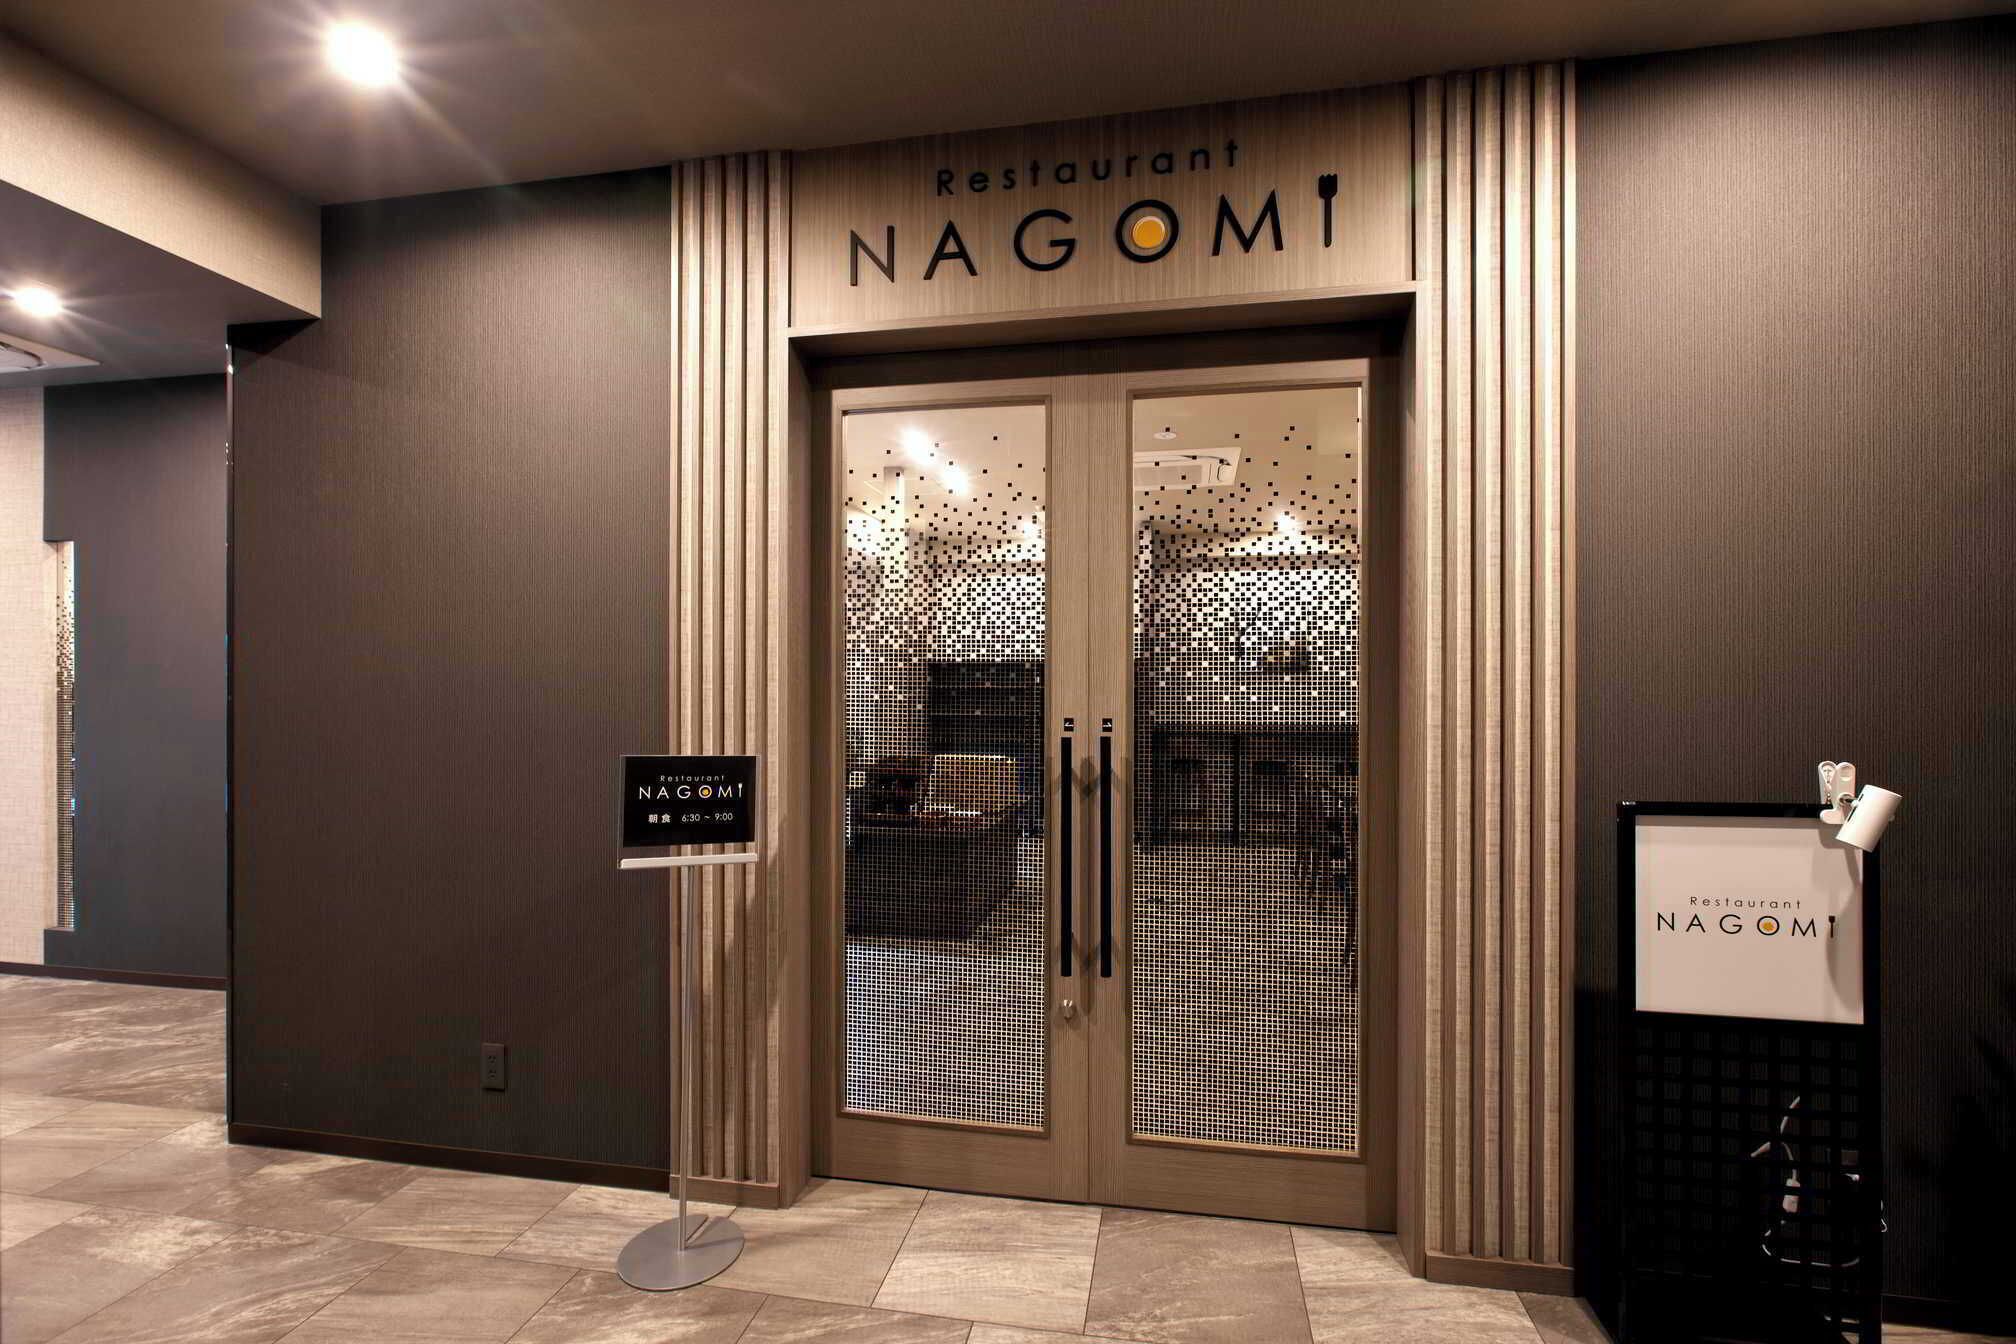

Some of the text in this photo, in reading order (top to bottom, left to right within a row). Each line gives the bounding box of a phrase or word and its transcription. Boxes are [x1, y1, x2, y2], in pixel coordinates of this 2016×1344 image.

[936, 138, 1239, 197] Restaurant
[849, 172, 1339, 288] NAGOMI
[659, 774, 725, 783] Restaurant
[638, 783, 743, 800] NAGOMI
[681, 813, 701, 823] 6:30
[714, 812, 734, 822] 9:00
[1689, 896, 1801, 910] Restaurant
[1656, 912, 1836, 939] NAGOMI
